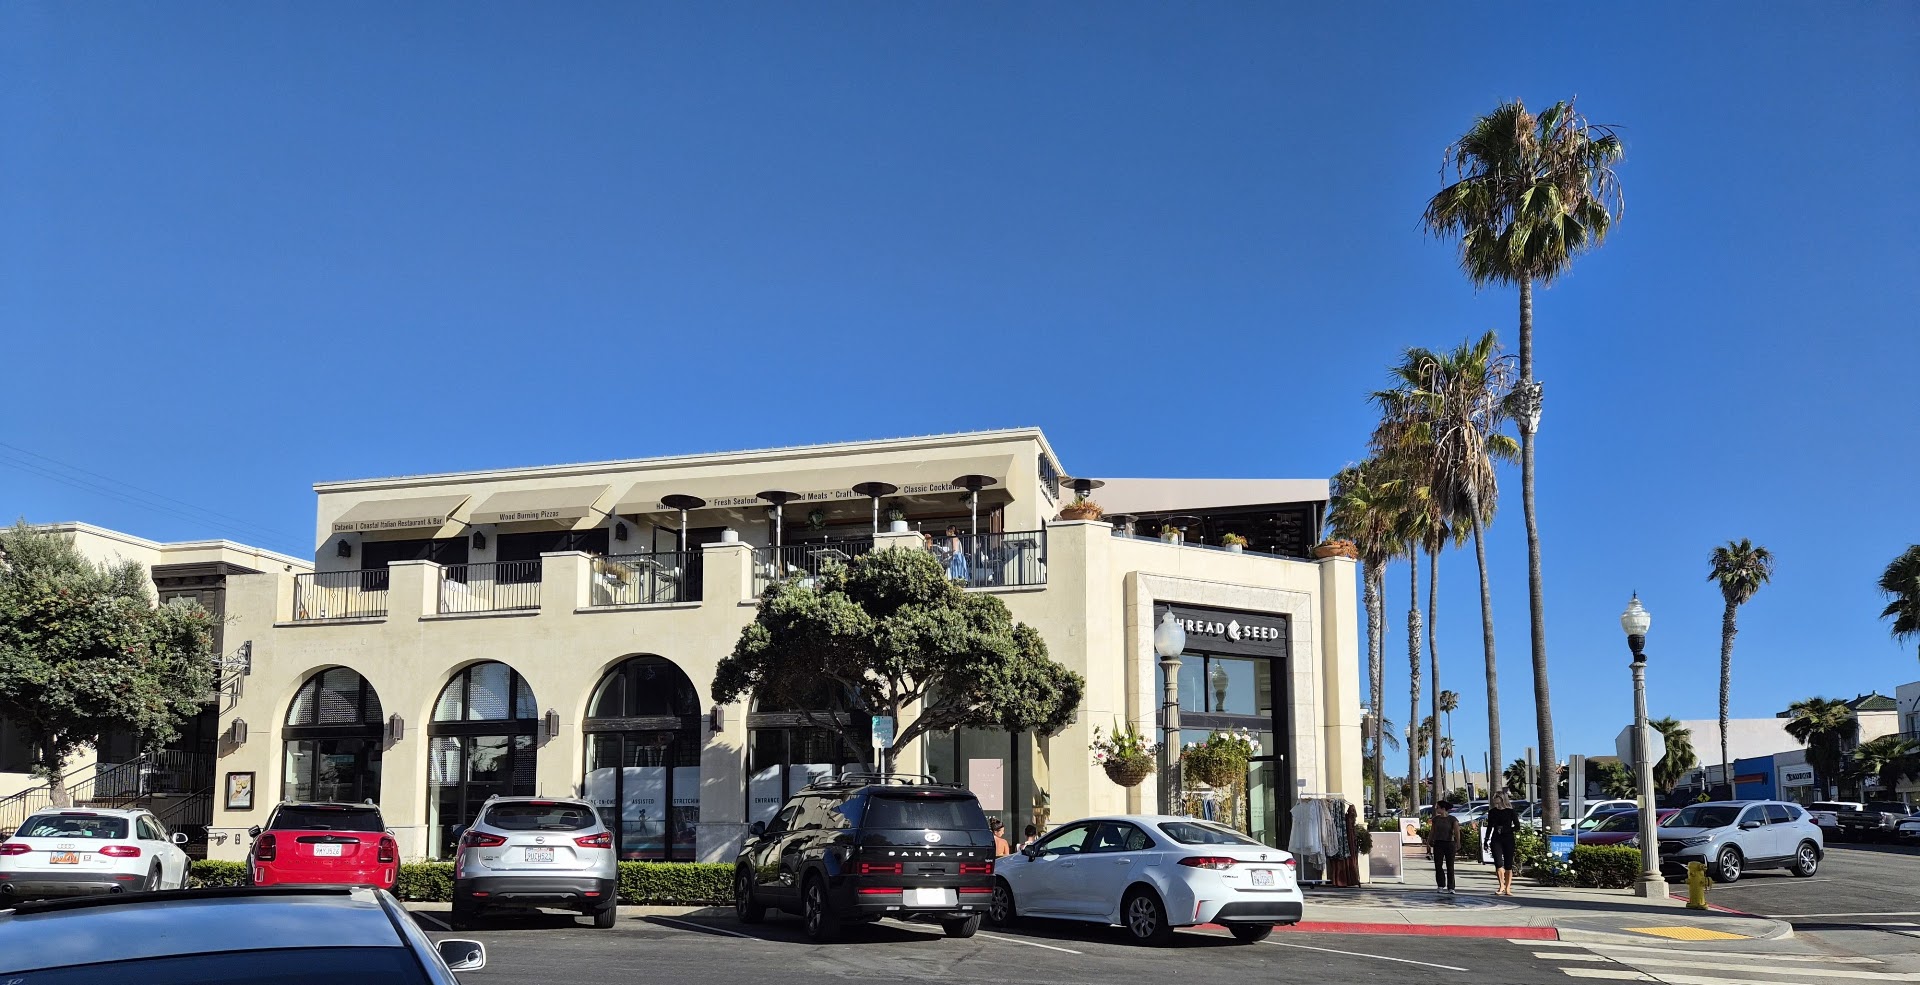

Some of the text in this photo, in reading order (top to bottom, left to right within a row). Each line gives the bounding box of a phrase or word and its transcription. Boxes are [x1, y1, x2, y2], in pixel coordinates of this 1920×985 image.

[714, 498, 731, 506] Fresh
[734, 497, 758, 505] Seafood
[808, 492, 827, 500] Meats
[835, 490, 852, 498] Craft
[904, 485, 927, 493] Classic
[1177, 619, 1225, 634] HREAD
[1244, 625, 1278, 639] SEED
